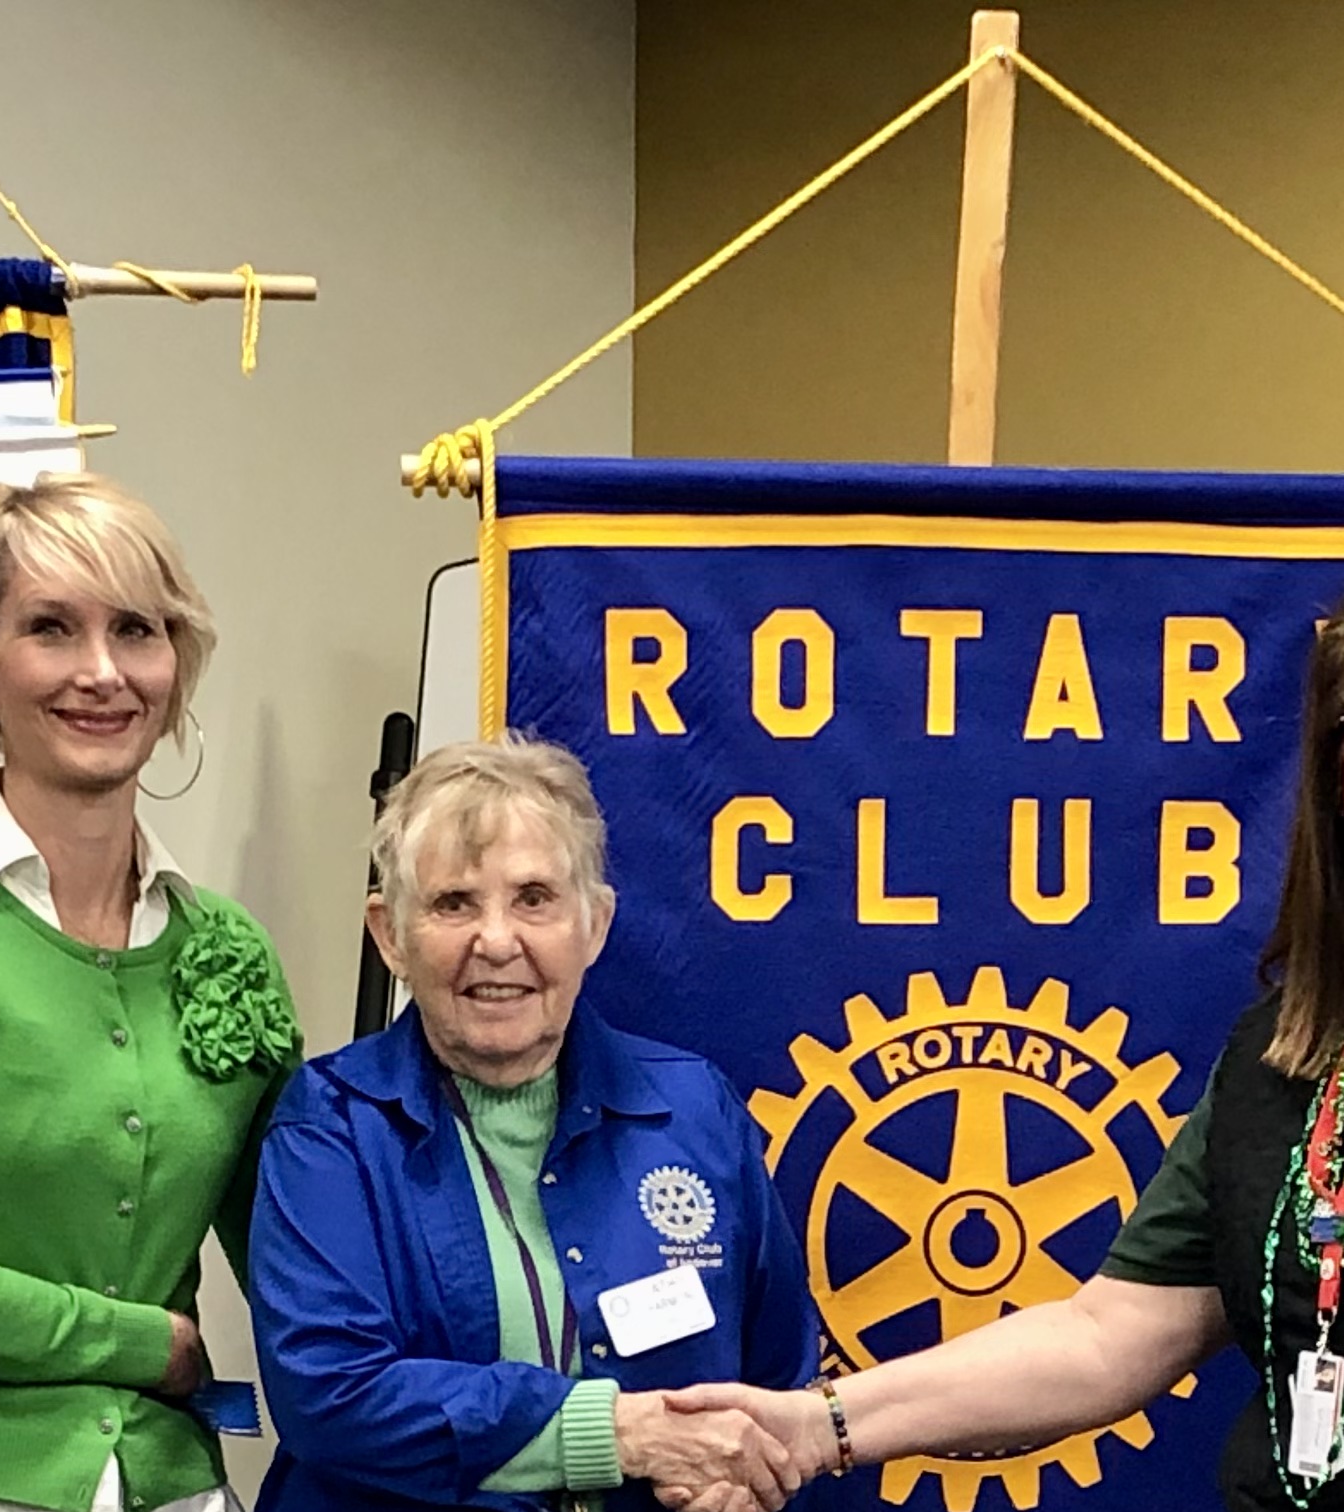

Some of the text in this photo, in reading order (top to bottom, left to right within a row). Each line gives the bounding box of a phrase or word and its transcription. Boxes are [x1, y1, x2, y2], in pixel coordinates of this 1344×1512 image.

[604, 608, 1320, 742] ROTAR
[710, 796, 1243, 926] CLUB
[875, 1026, 1093, 1091] ROTARY
